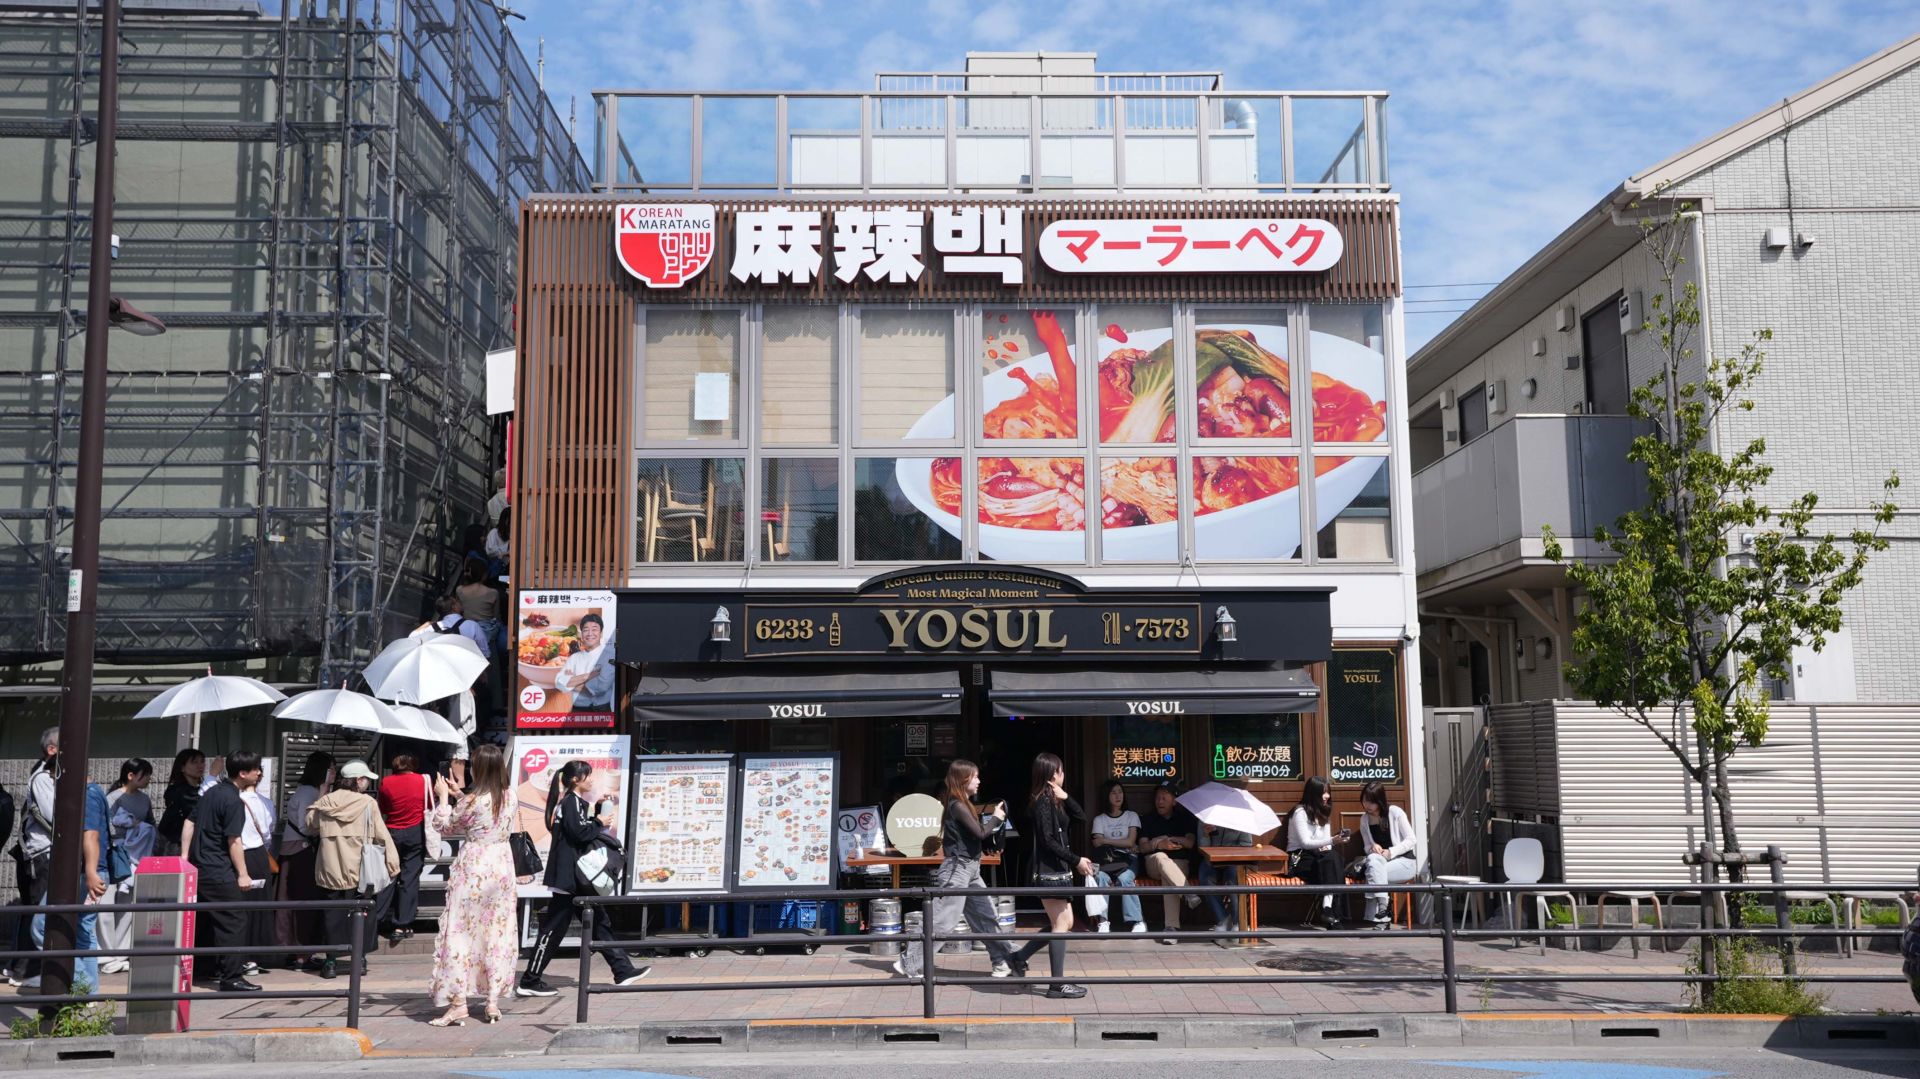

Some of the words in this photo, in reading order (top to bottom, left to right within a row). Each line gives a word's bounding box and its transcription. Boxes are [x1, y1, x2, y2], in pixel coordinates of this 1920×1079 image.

[638, 219, 711, 229] MARATANG
[730, 205, 1023, 285] 麻辣백
[1057, 223, 1325, 267] マーラーペク
[884, 573, 932, 589] Korean
[935, 571, 985, 581] Cuisine
[988, 571, 1062, 589] Restaurant
[907, 588, 938, 598] Most
[939, 587, 987, 600] Magical
[989, 588, 1040, 598] Moment
[755, 618, 814, 640] 6233
[879, 609, 1068, 648] YOSUL
[1135, 618, 1190, 639] 7573
[1344, 674, 1381, 683] YOSUL
[523, 692, 543, 704] 2F
[768, 704, 827, 718] YOSUL
[1126, 701, 1185, 714] YOSUL
[1112, 747, 1176, 764] 営業時間
[1225, 745, 1291, 762] 飲み放題
[525, 754, 546, 768] 2F
[1332, 756, 1372, 767] Follow
[1375, 756, 1393, 767] us!
[1227, 765, 1291, 777] 980円90分
[1331, 768, 1396, 780] @yosul2022
[896, 817, 941, 828] YOSUL
